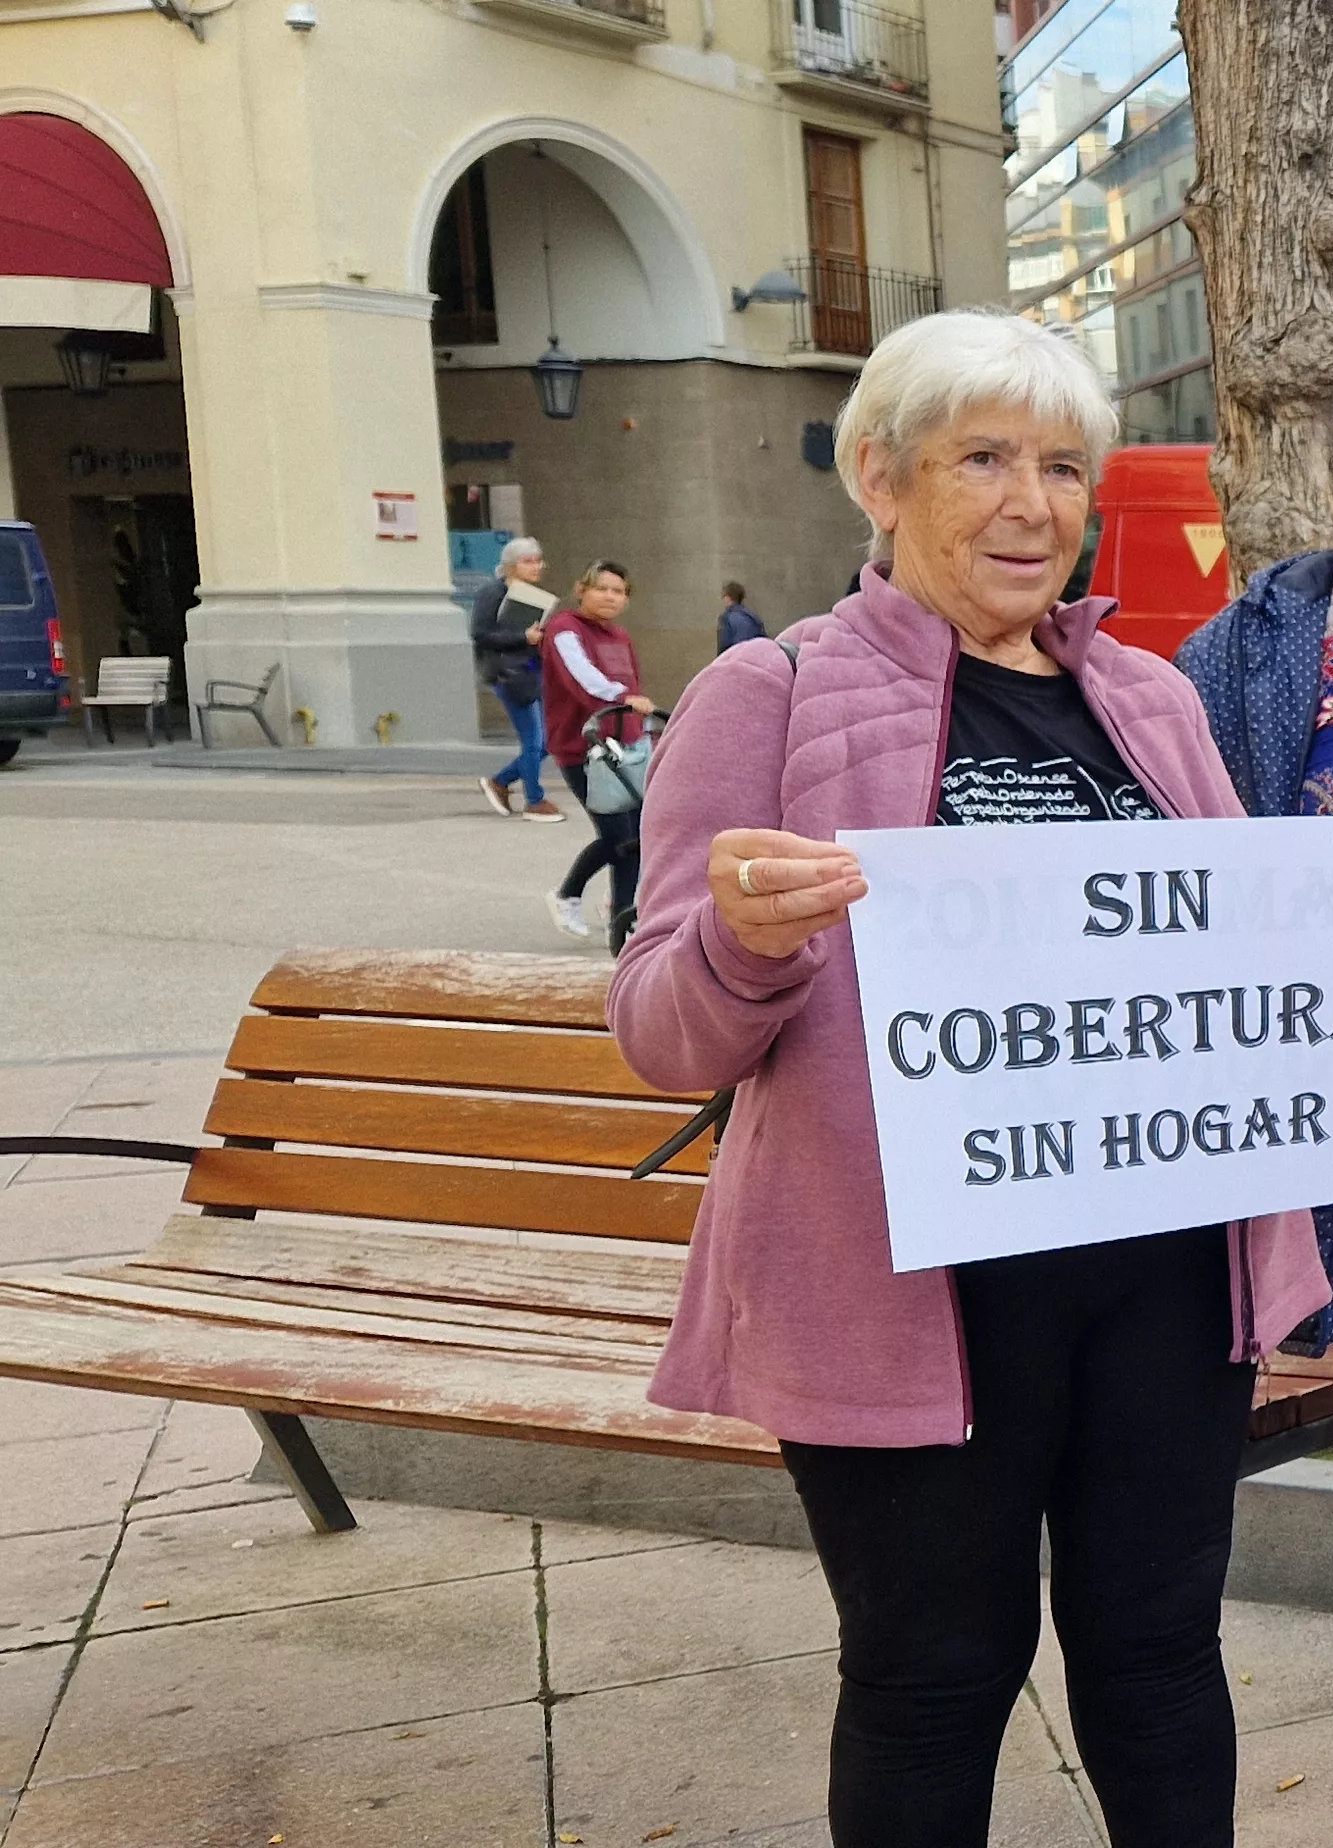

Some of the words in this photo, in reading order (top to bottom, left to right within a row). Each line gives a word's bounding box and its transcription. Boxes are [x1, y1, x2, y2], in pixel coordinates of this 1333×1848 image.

[1082, 868, 1213, 938] SIN
[963, 1119, 1077, 1187] SIN
[1099, 1091, 1331, 1171] HOGAR
